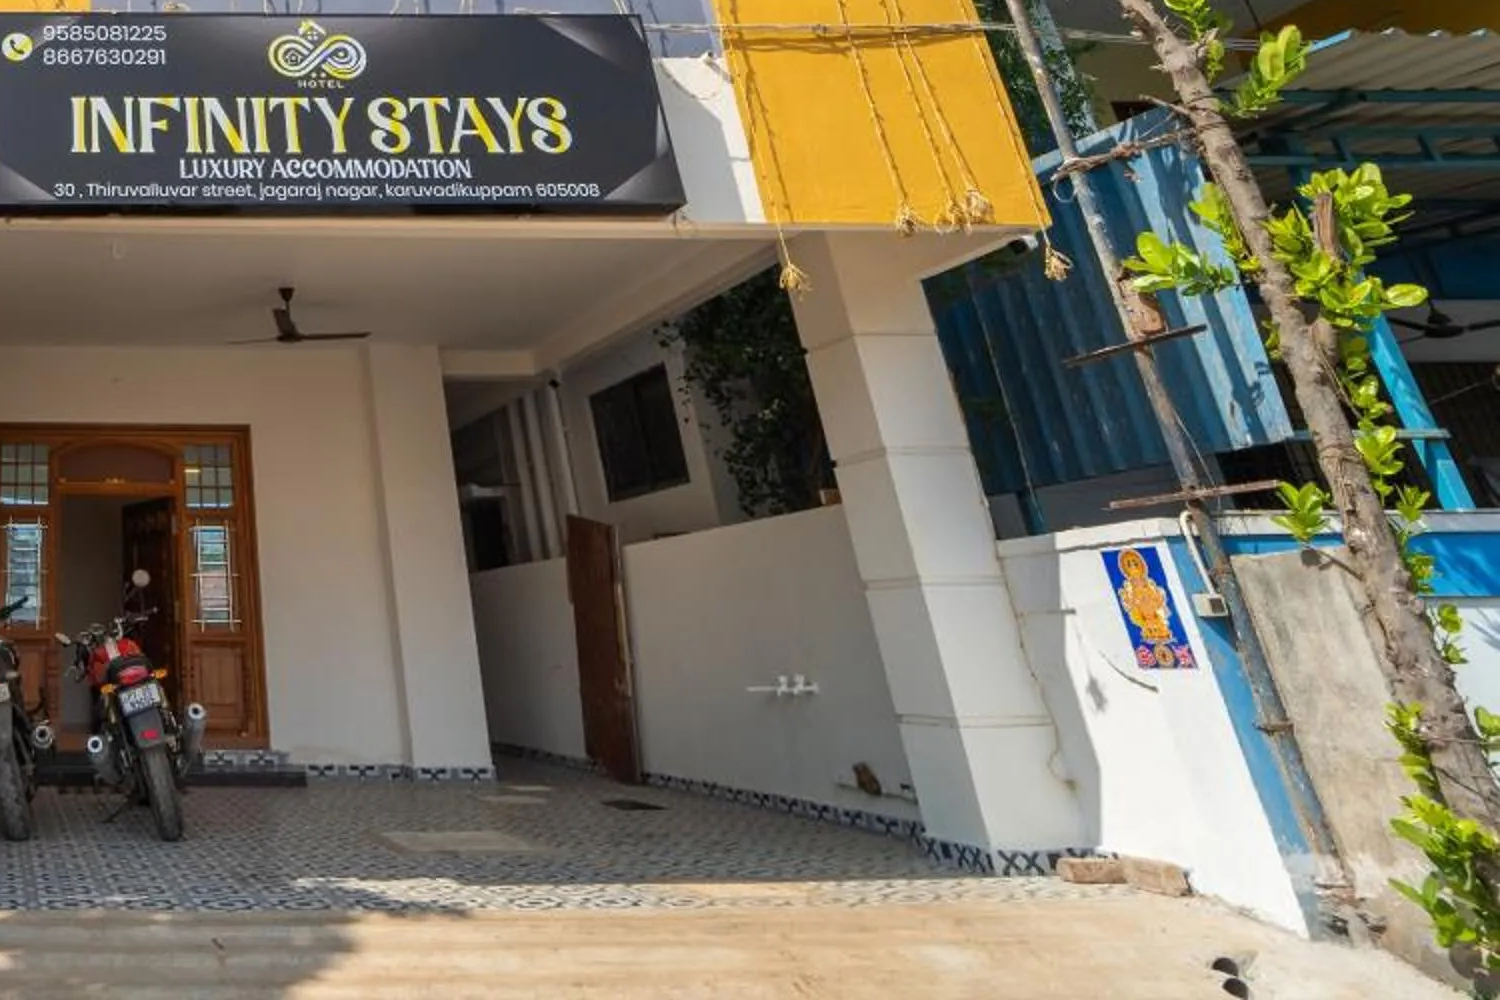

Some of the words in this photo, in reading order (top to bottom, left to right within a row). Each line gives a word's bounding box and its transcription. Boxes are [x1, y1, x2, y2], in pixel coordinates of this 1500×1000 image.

[42, 25, 168, 42] 9585081225
[42, 48, 167, 66] 8667630291
[297, 79, 345, 89] HOTEL
[71, 96, 353, 154] INFINITY
[367, 96, 573, 155] STAYS
[179, 158, 266, 180] LUXURY
[271, 158, 473, 180] ACCOMMODATION
[53, 183, 76, 198] 30
[86, 183, 197, 198] Thiruvalluvar
[202, 183, 257, 200] street,
[258, 183, 322, 201] jagaraj
[325, 184, 384, 201] nagar,
[385, 183, 533, 201] karuvadikuppam
[535, 183, 601, 198] 605008
